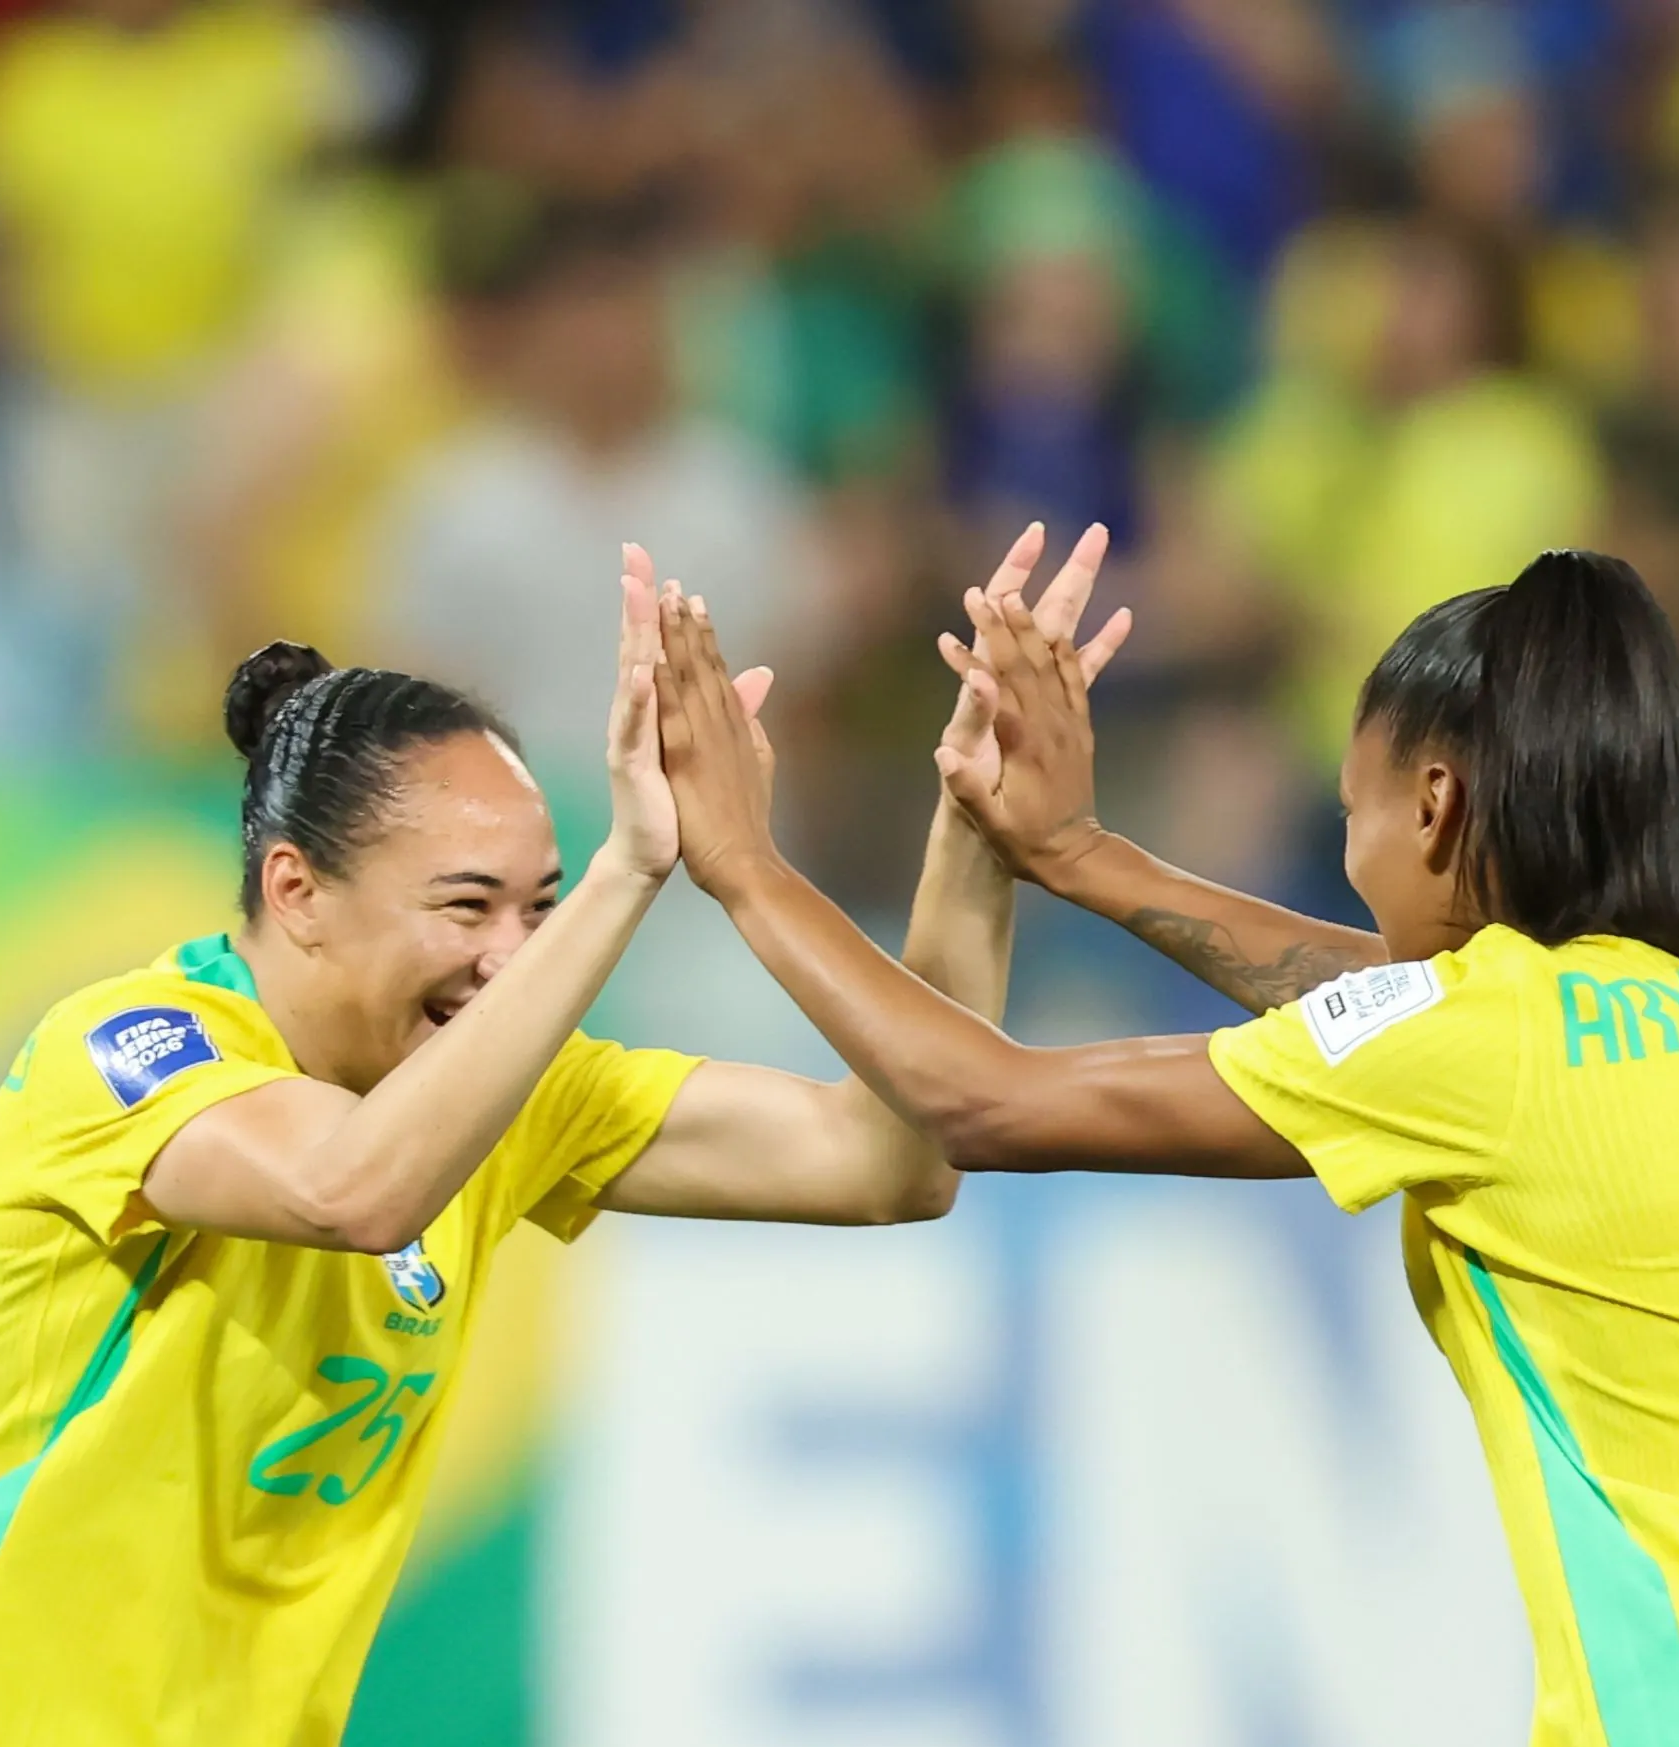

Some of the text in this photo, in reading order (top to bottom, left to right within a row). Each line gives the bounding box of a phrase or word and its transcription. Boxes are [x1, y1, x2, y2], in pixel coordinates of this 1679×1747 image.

[114, 1017, 171, 1047] FIFA
[126, 1036, 184, 1077] 2026
[249, 1354, 436, 1505] 25
